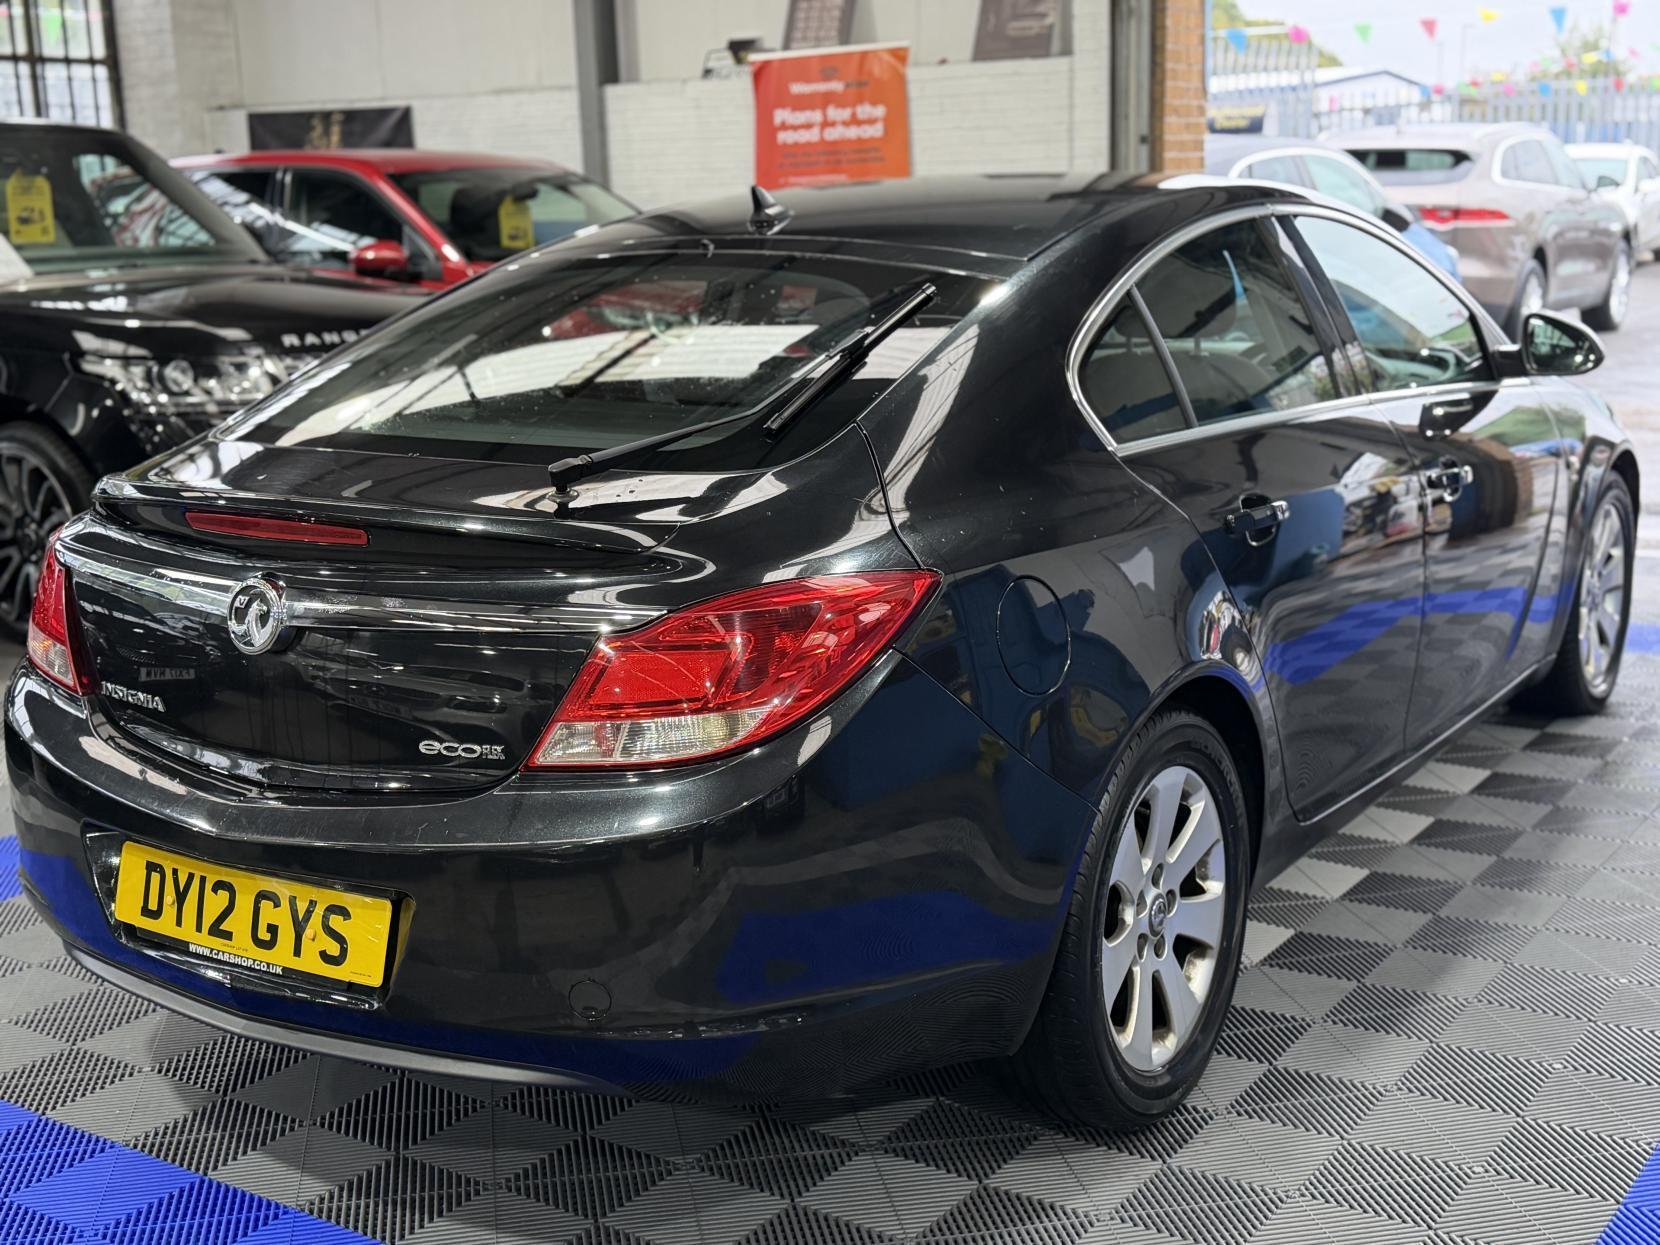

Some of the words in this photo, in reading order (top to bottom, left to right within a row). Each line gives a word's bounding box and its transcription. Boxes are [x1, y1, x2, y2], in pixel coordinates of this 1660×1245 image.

[773, 107, 822, 127] Plans
[825, 104, 851, 122] for
[855, 101, 886, 119] the
[776, 125, 821, 145] road
[823, 120, 884, 141] ahead
[101, 680, 166, 712] INSIGNIA
[140, 859, 237, 942] DY12
[250, 889, 352, 967] GYS
[188, 942, 283, 975] WWW.CARSHOP.CO.UK
